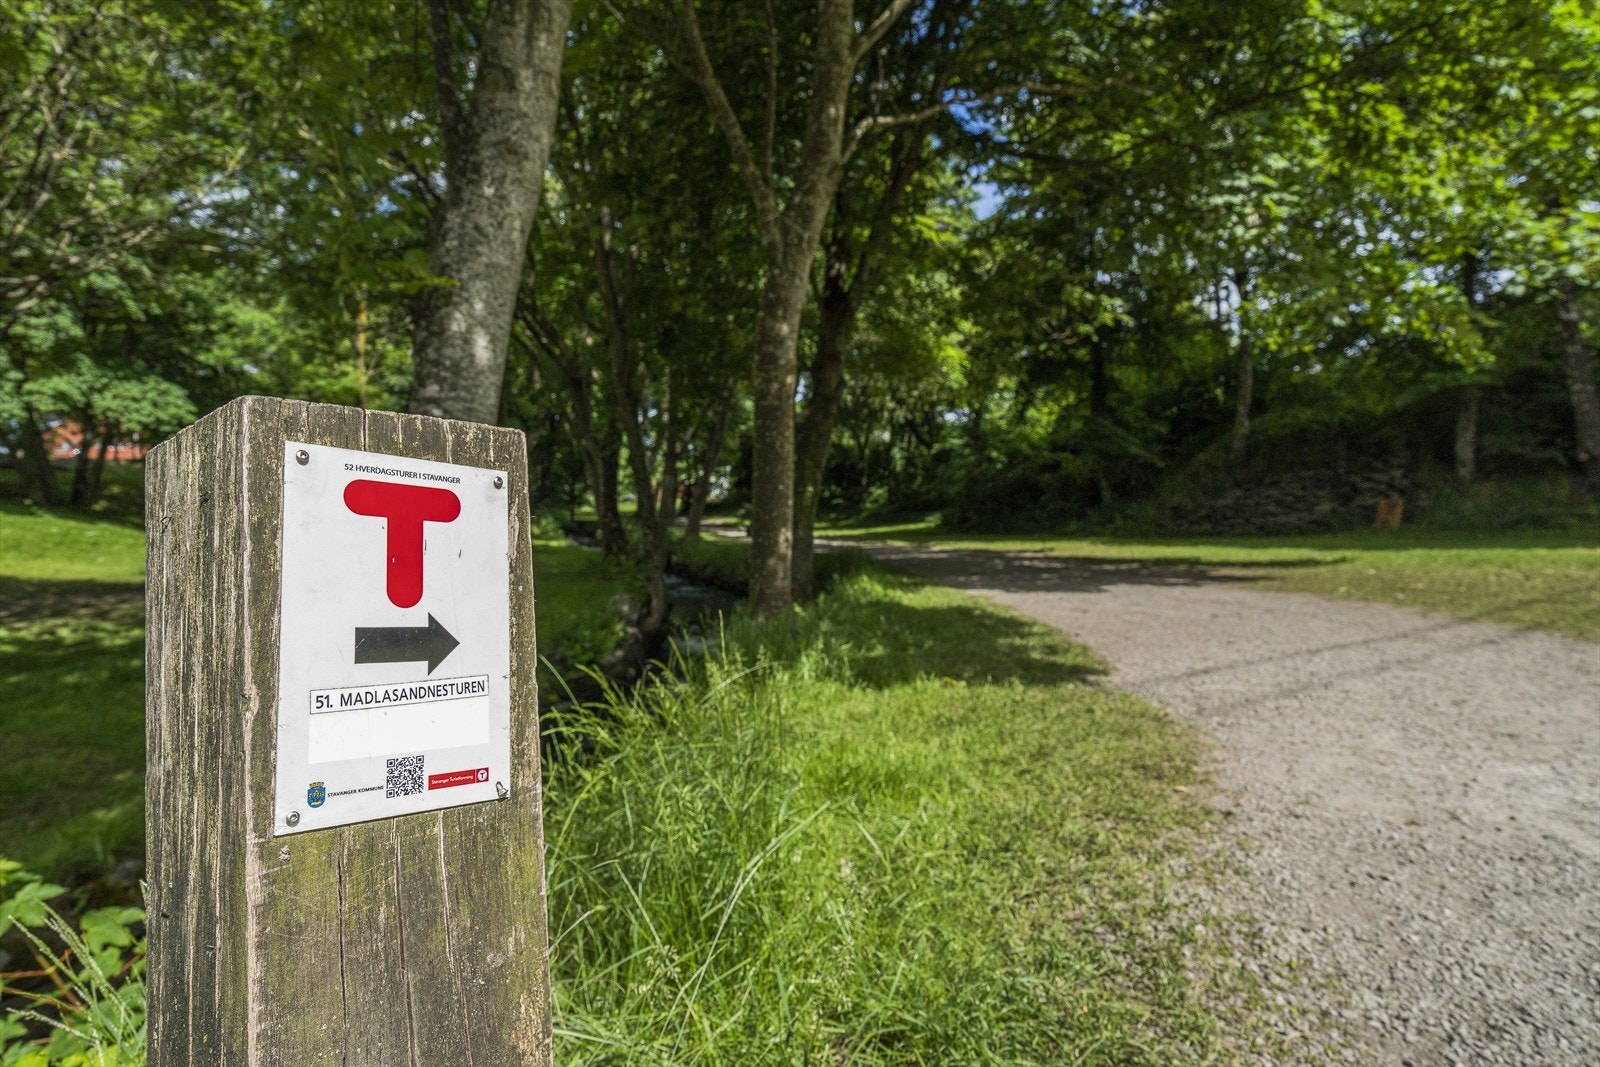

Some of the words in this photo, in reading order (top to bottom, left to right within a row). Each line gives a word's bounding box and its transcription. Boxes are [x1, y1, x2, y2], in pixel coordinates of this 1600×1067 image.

[344, 463, 354, 471] 52
[355, 464, 418, 479] HVERDAGSTURER
[422, 473, 461, 484] STAVANGER
[343, 479, 461, 608] T
[316, 695, 333, 709] 51.
[340, 680, 485, 707] MADLASANDNESTUREN
[327, 789, 357, 798] STAVANGER
[357, 785, 384, 793] KOMMUNE
[431, 777, 450, 785] Stavanger
